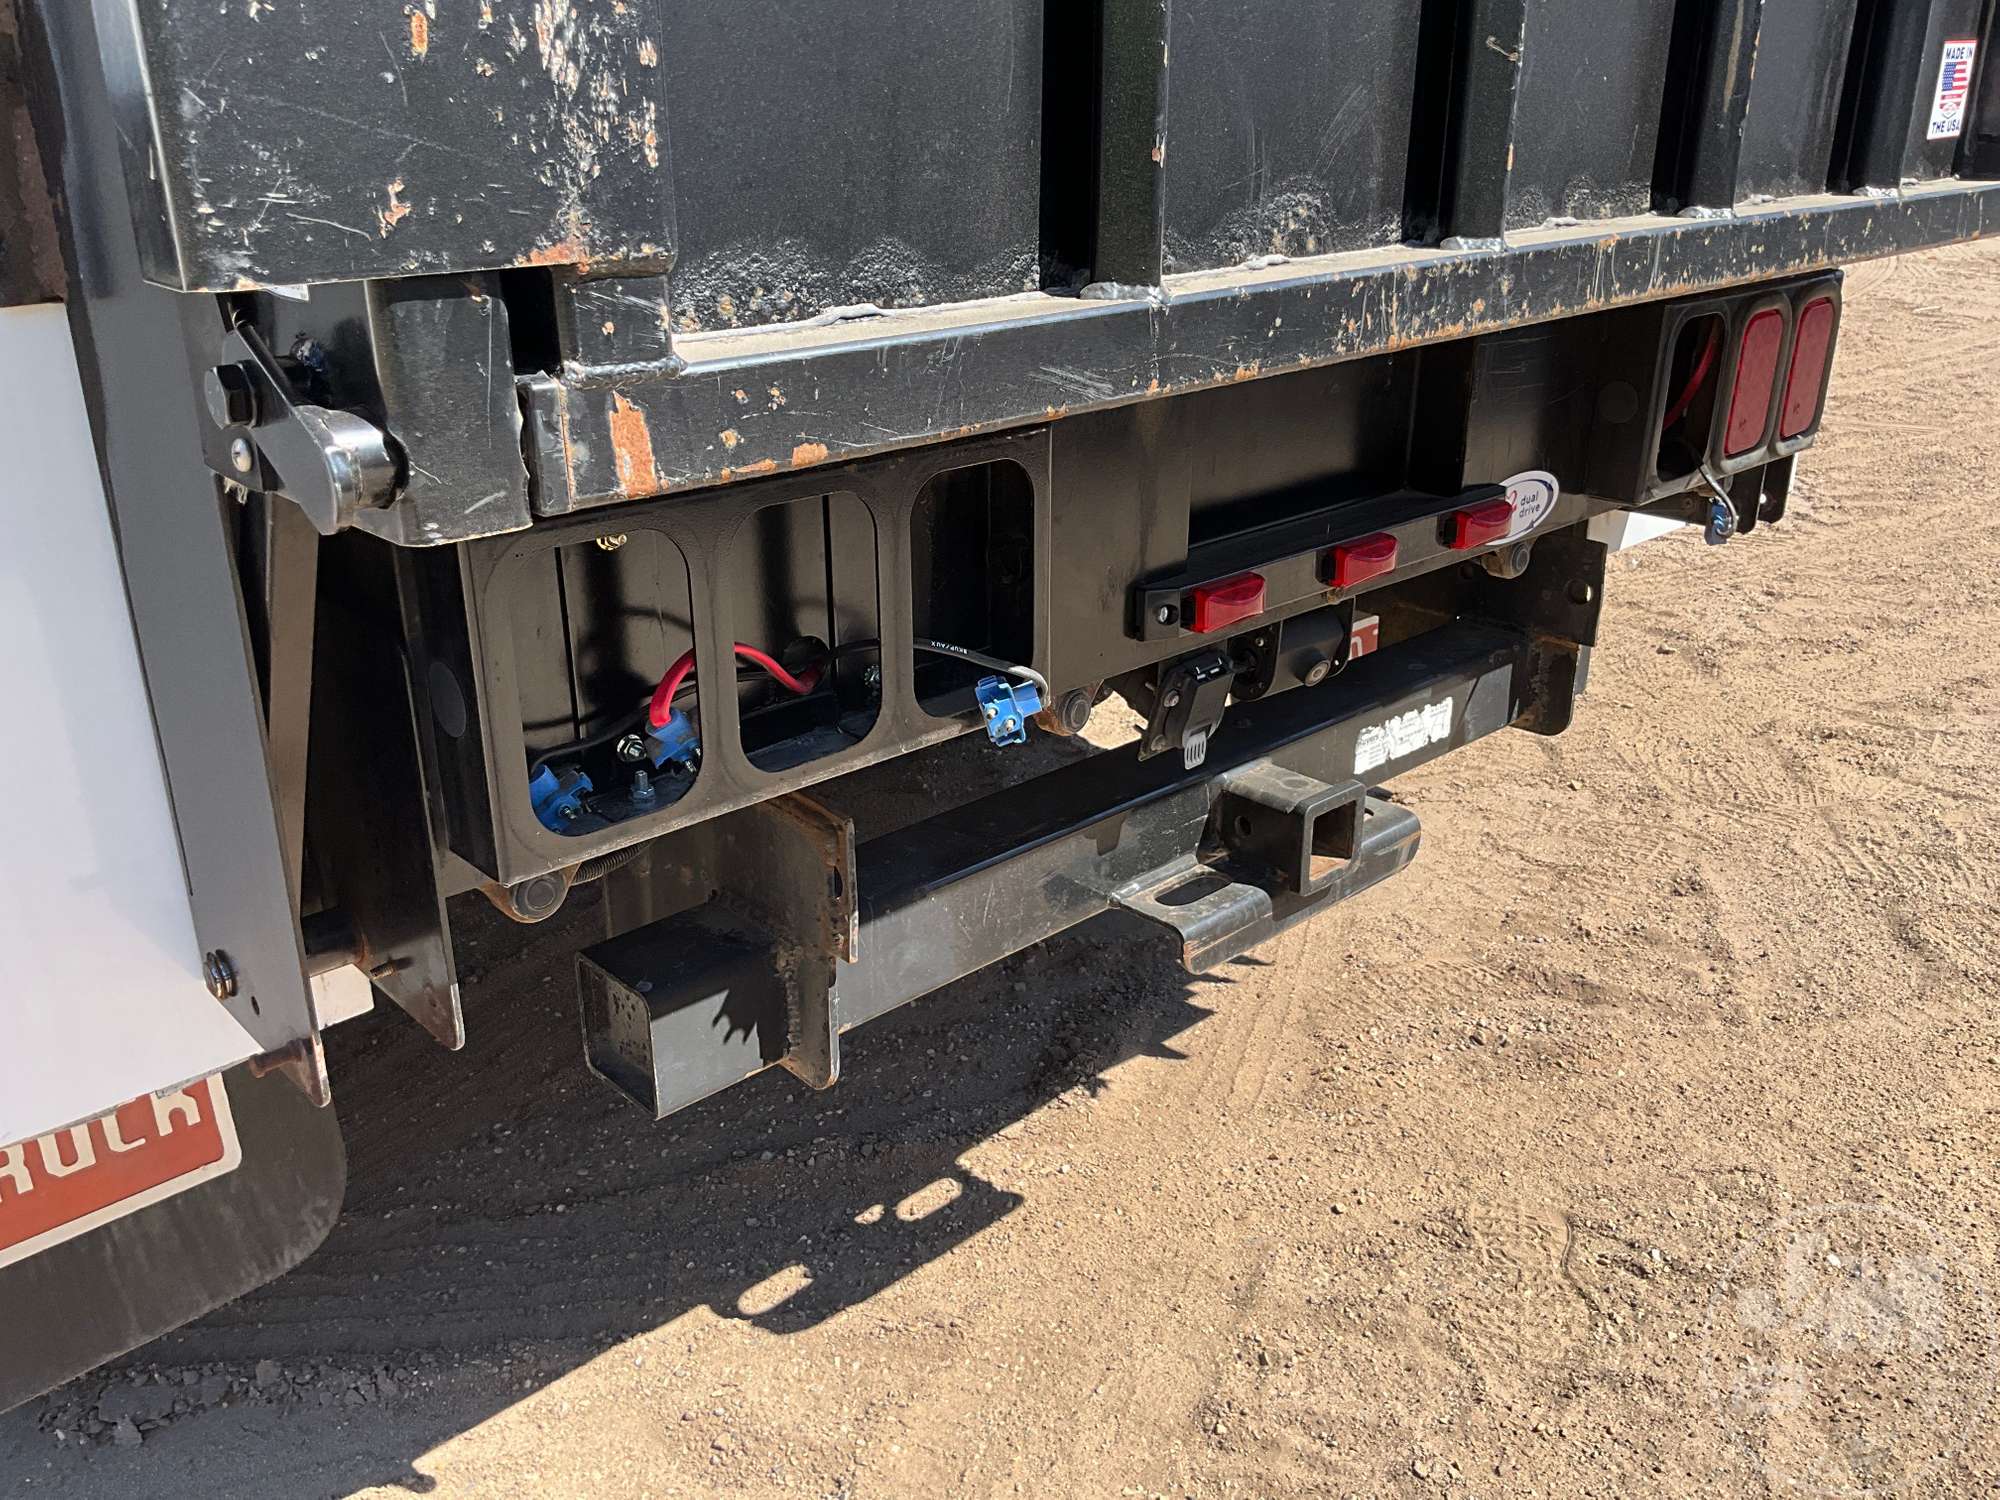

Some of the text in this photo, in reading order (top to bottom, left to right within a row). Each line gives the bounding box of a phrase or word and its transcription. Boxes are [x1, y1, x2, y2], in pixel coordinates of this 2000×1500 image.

[1945, 47, 1973, 59] MADE IN
[1931, 119, 1960, 134] THE USA
[1520, 490, 1539, 506] dual
[1519, 503, 1541, 518] drive
